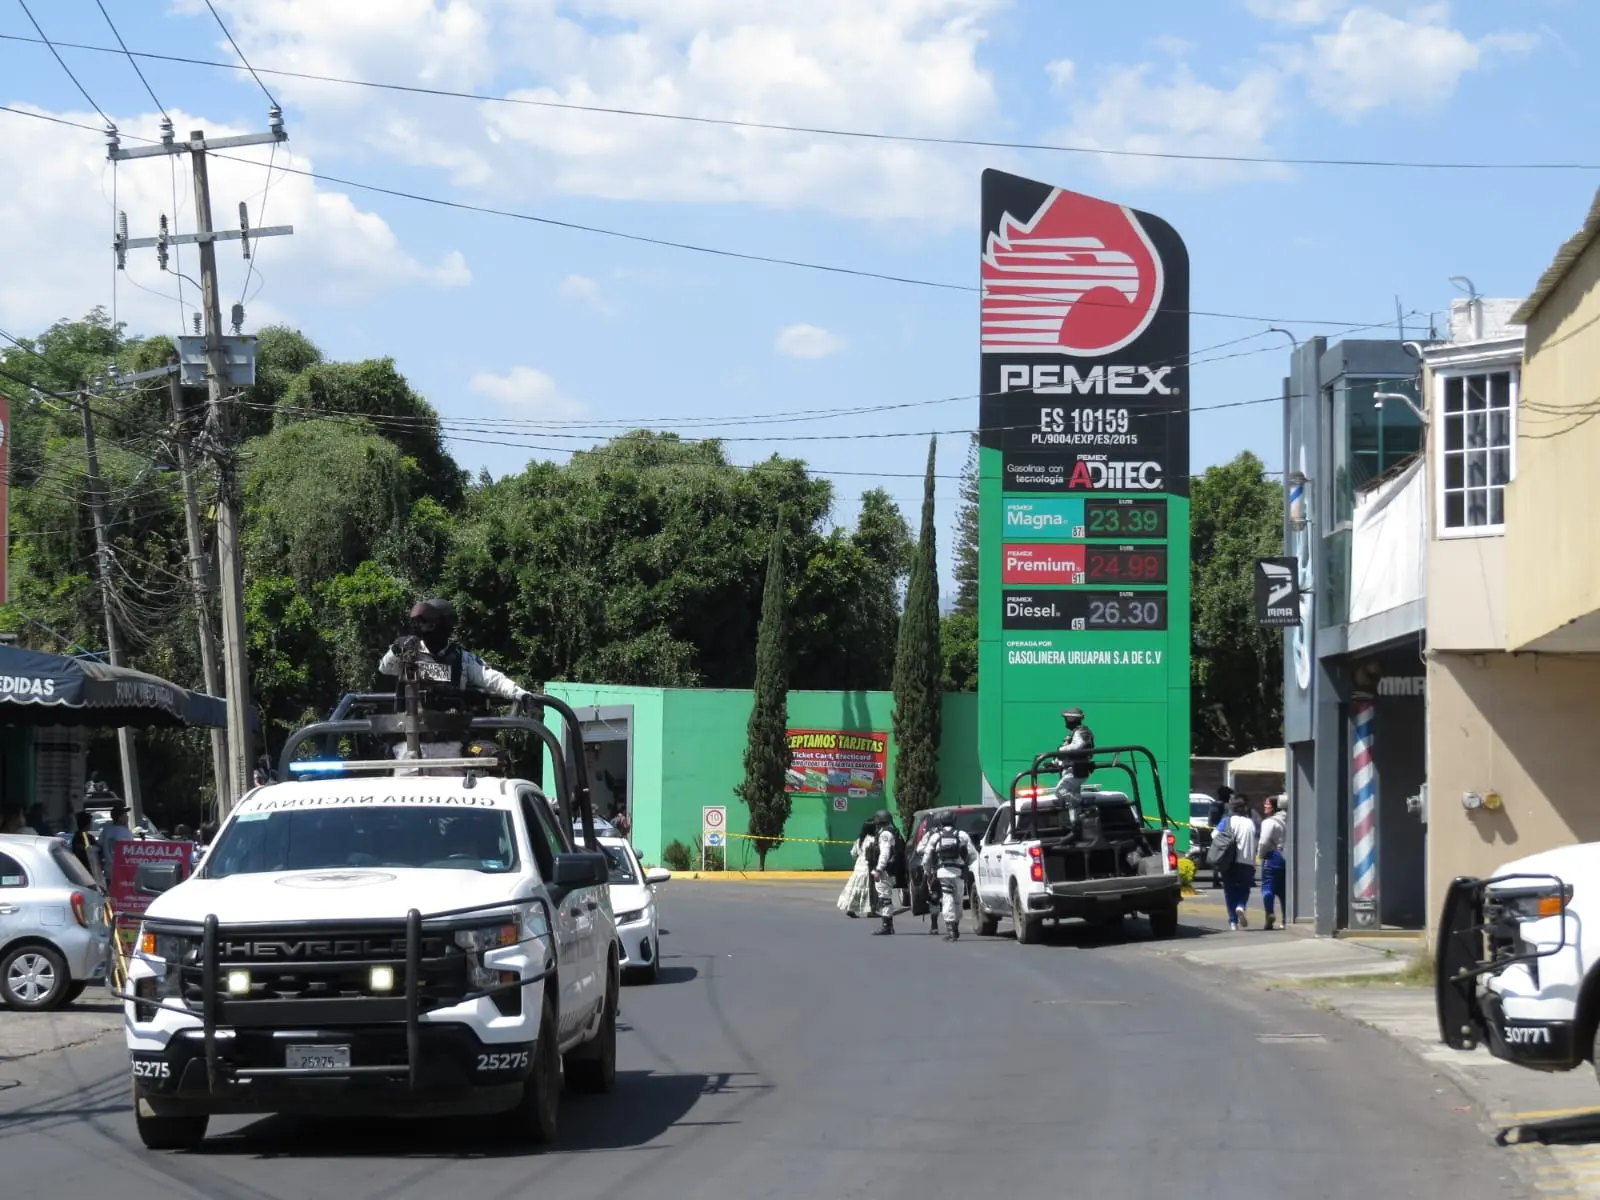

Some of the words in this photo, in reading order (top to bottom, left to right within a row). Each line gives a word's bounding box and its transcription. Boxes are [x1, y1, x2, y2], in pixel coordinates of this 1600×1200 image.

[1000, 364, 1175, 395] PEMEX
[1040, 407, 1064, 433] ES
[1071, 408, 1129, 433] 10159
[1031, 433, 1138, 445] PL/9004/EXP/ES/2015
[1007, 464, 1045, 473] Gasolinas
[1048, 465, 1064, 473] con
[1007, 511, 1063, 529] Magna
[1089, 509, 1159, 532] 23.39
[1007, 557, 1076, 571] Premium
[1089, 554, 1159, 578] 24.99
[1006, 603, 1055, 617] Diesel
[1089, 601, 1159, 624] 26.30
[1008, 651, 1065, 664] GASOLINERA
[1068, 651, 1111, 664] URUAPAN
[1131, 651, 1143, 664] DE
[838, 736, 884, 753] TARJETAS
[792, 751, 813, 759] Ticket
[123, 846, 183, 857] MAGALA
[477, 1052, 528, 1070] 25275
